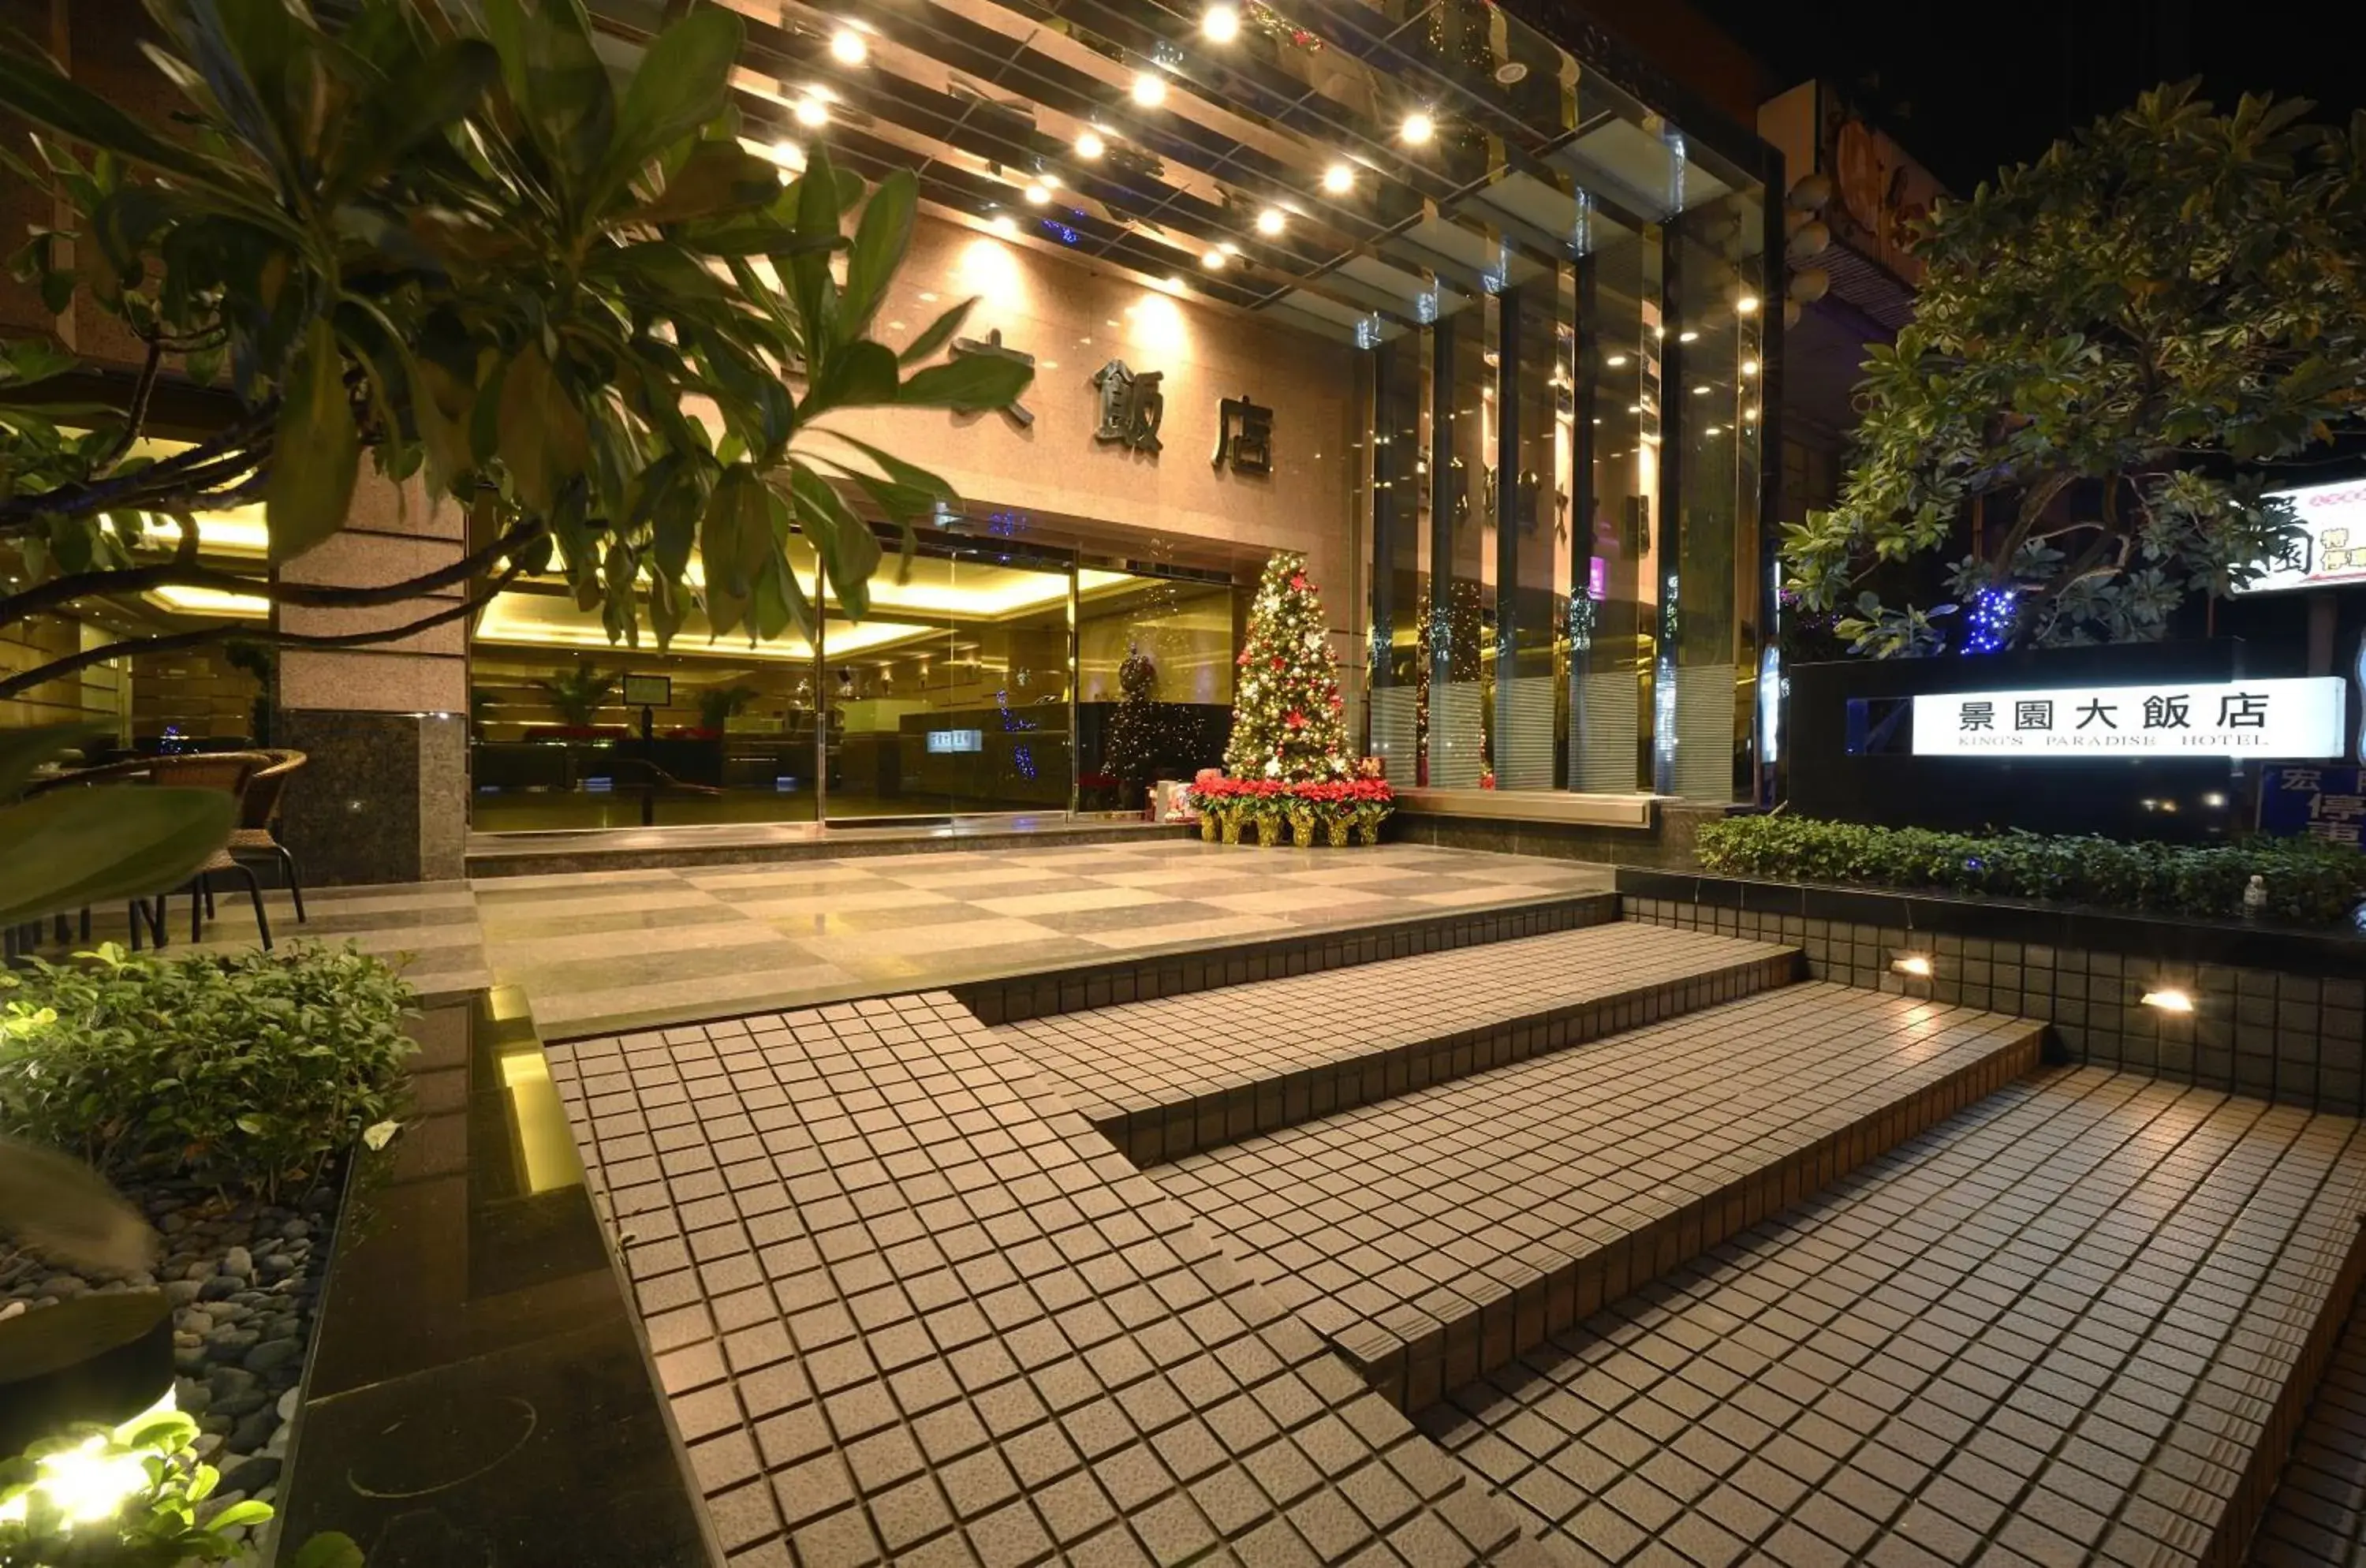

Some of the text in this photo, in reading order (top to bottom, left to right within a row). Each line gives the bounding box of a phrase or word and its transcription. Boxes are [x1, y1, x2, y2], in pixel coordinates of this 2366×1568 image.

[1959, 692, 2270, 730] 景園大飯店
[1958, 734, 2270, 746] KING'S PARADISE HOTEL
